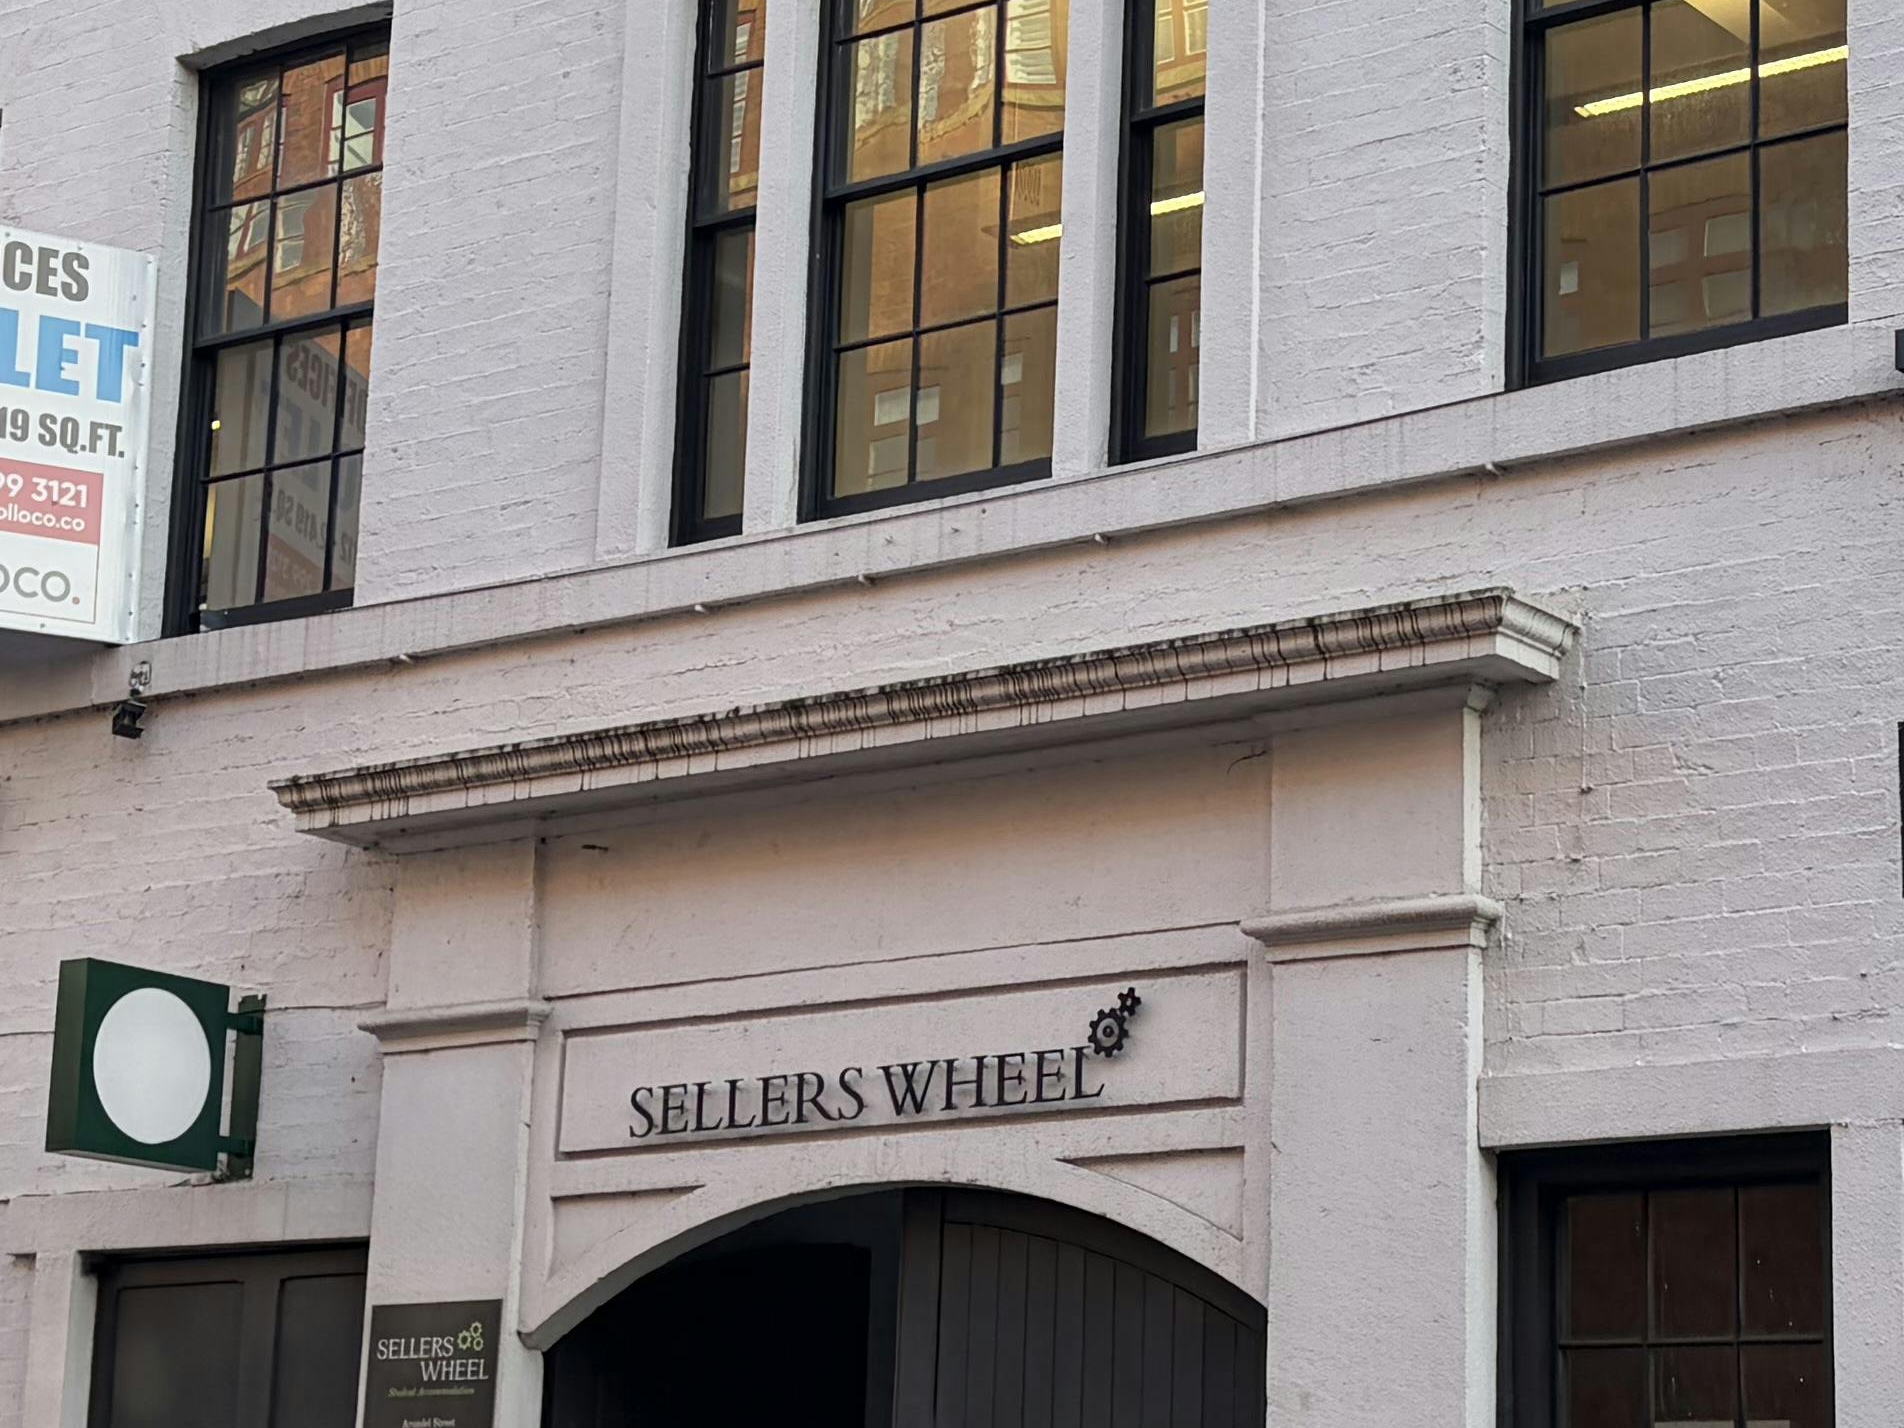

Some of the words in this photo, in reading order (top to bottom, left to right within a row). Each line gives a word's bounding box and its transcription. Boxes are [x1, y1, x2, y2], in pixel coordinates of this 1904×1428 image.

[38, 413, 125, 458] SQ.FT.
[32, 477, 88, 508] 3121
[628, 1067, 865, 1139] SELLERS
[877, 1045, 1104, 1117] WHEEL
[376, 1336, 454, 1361] SELLERS
[420, 1358, 489, 1381] WHEEL
